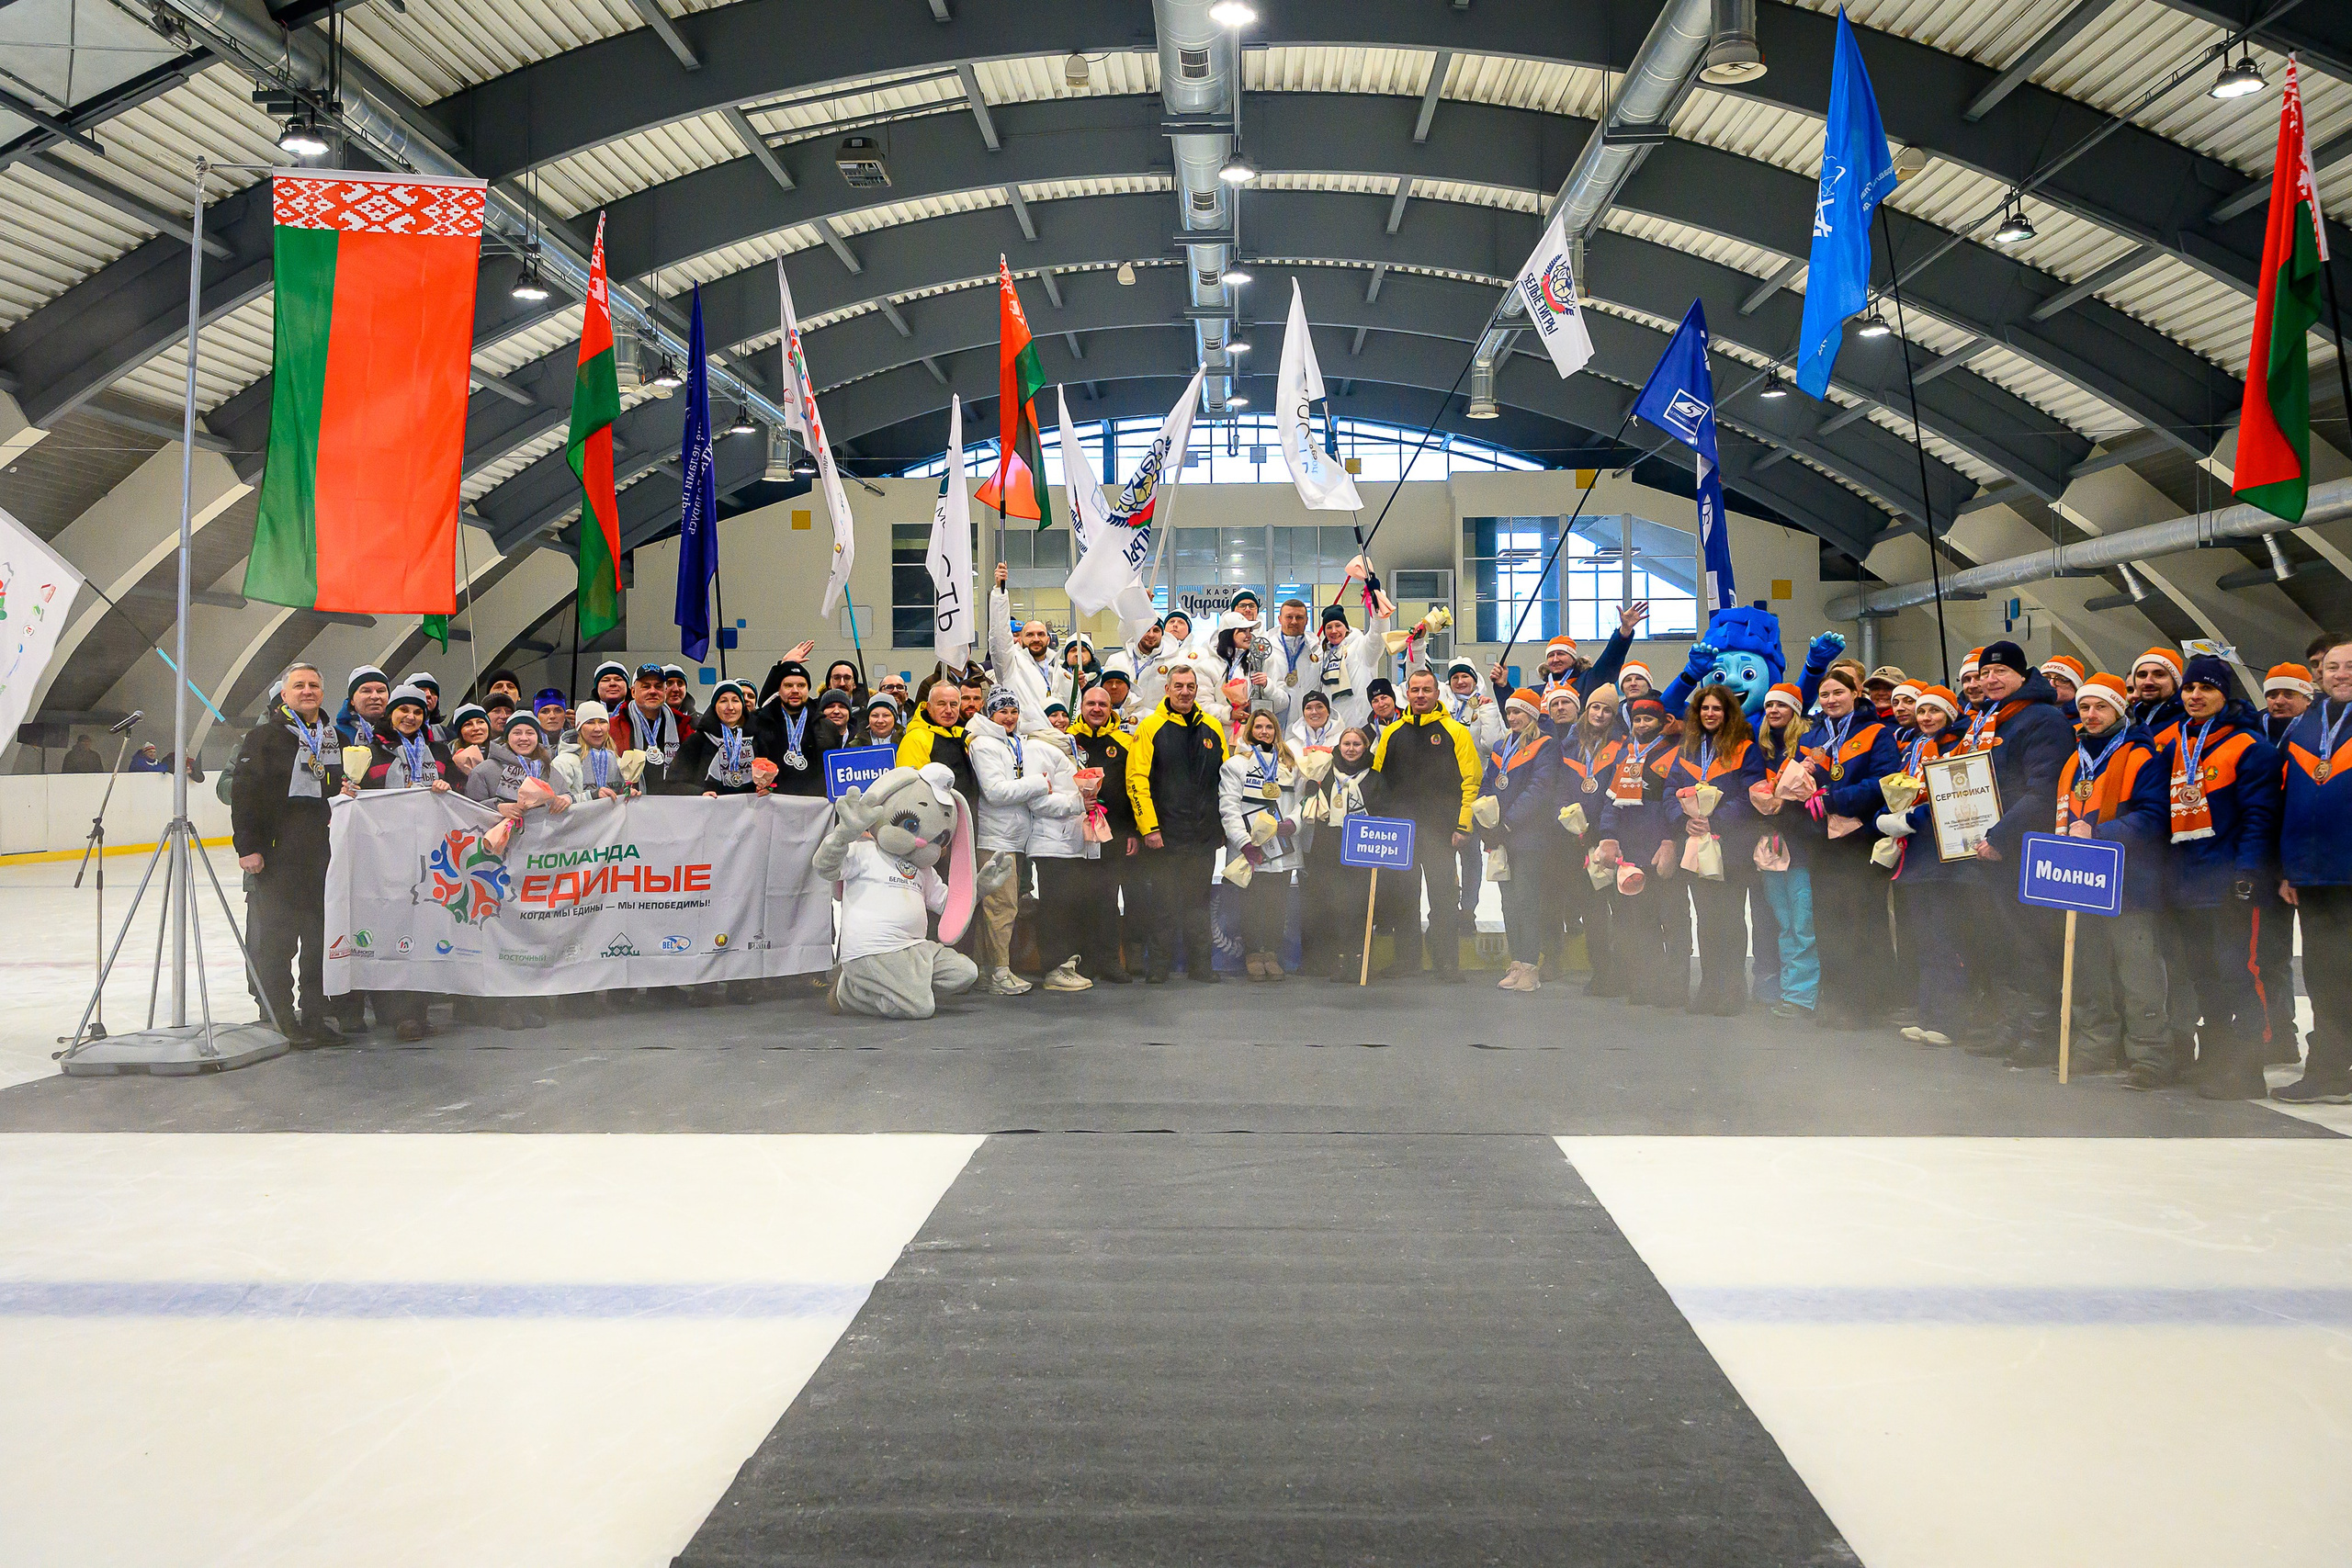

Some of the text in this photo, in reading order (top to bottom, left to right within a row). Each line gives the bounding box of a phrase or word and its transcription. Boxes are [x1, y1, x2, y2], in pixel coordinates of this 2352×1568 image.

[1538, 303, 1559, 335] ТИГРЫ
[1935, 785, 1990, 802] СЕРТИФИКАТ
[1360, 826, 1398, 841] Белые
[526, 844, 640, 869] КОМАНДА
[1356, 843, 1398, 858] тигры
[520, 863, 712, 908] ЕДИНЫЕ
[2035, 860, 2107, 889] Молния
[520, 909, 551, 920] КОГДА
[553, 908, 571, 918] МЫ
[572, 903, 604, 917] ЕДИНЫ
[617, 901, 635, 909] МЫ
[638, 899, 711, 910] НЕПОБЕДИМЫ!
